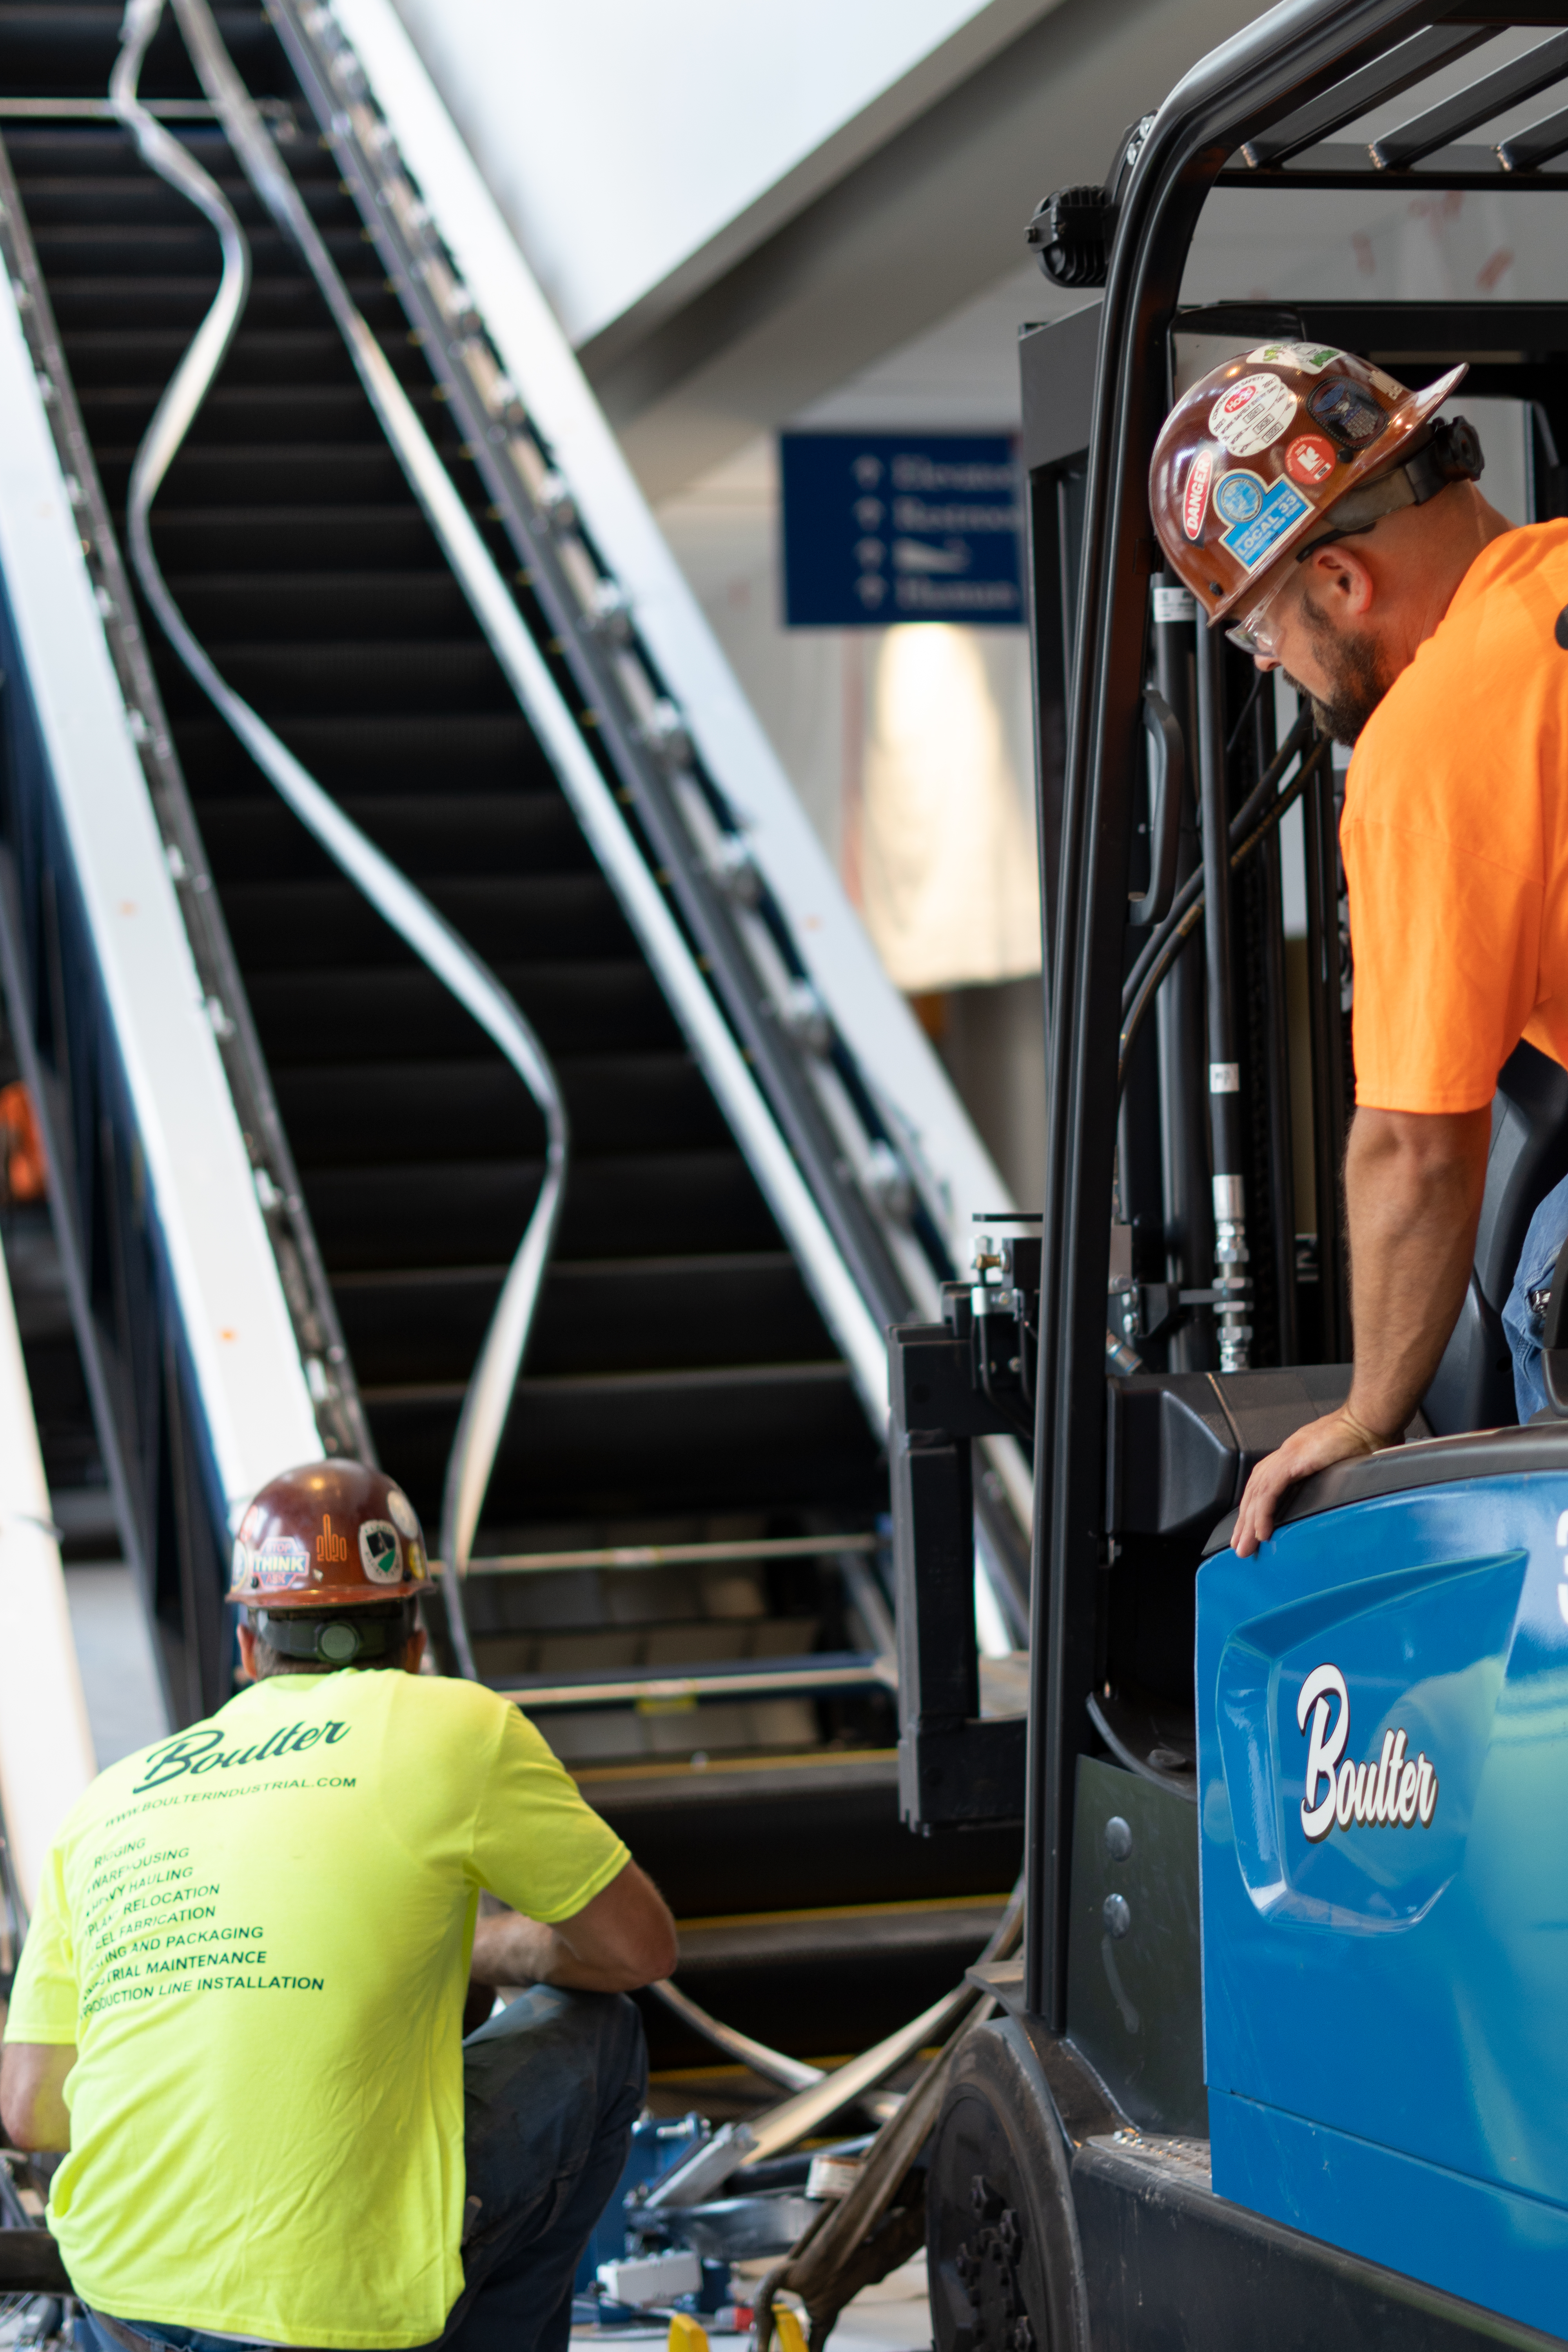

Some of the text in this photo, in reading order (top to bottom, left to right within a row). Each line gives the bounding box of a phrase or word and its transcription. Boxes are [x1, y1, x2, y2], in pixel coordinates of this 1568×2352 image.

[1241, 375, 1265, 385] SAFETY
[1226, 387, 1253, 412] Hood
[1214, 418, 1226, 432] 2021
[1221, 421, 1234, 434] WORK
[1234, 405, 1251, 421] SAFELY
[1187, 459, 1210, 530] DANGER
[1238, 515, 1279, 555] LOCAL
[1278, 494, 1296, 514] 33
[266, 1543, 291, 1552] STOP
[316, 1514, 347, 1562] 2020
[255, 1556, 305, 1572] THINK
[266, 1573, 286, 1584] ASK
[133, 1720, 351, 1794] Boulter
[1296, 1662, 1439, 1844] Boulter
[106, 1777, 356, 1828] WWW.BOULTERINDUSTRIAL.COM
[94, 1838, 146, 1868] RIGGING
[92, 1847, 189, 1890] WAREHOUSING
[129, 1867, 193, 1893] HAULING
[124, 1884, 220, 1915] RELOCATION
[120, 1906, 216, 1938] FABRICATION
[131, 1938, 160, 1954] AND
[167, 1926, 263, 1948] PACKAGING
[146, 1951, 267, 1974] MAINTENANCE
[83, 1976, 324, 2018] PRODUCTION LINE INSTALLATION
